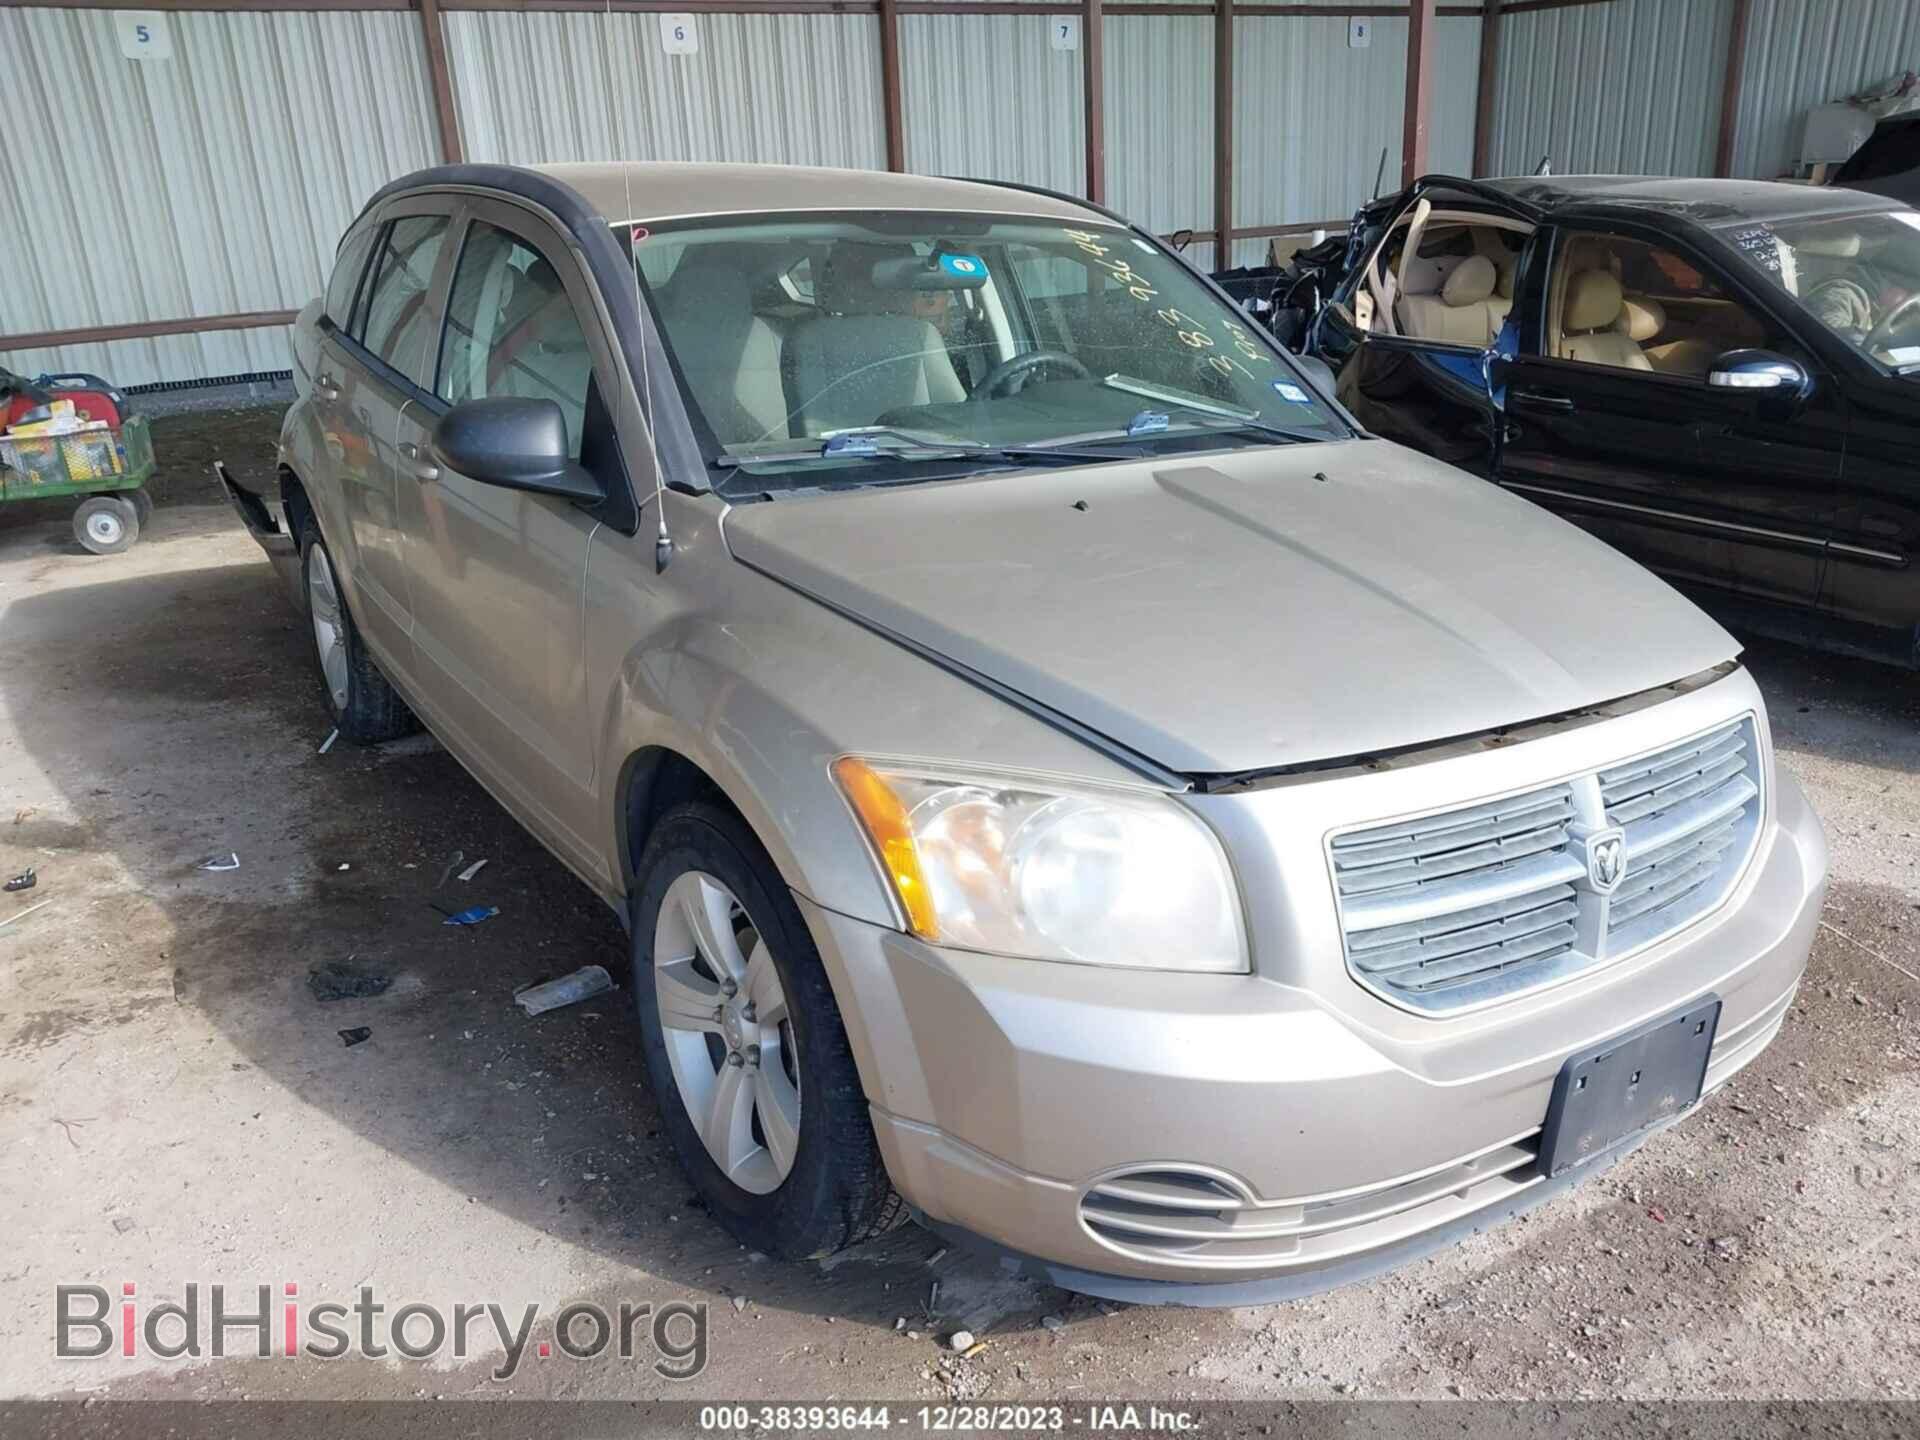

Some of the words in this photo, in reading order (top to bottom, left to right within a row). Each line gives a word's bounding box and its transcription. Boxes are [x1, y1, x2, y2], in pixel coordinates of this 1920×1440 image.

[136, 25, 149, 42] 5
[675, 26, 684, 40] 6
[1061, 25, 1068, 38] 7
[1357, 25, 1363, 37] 8
